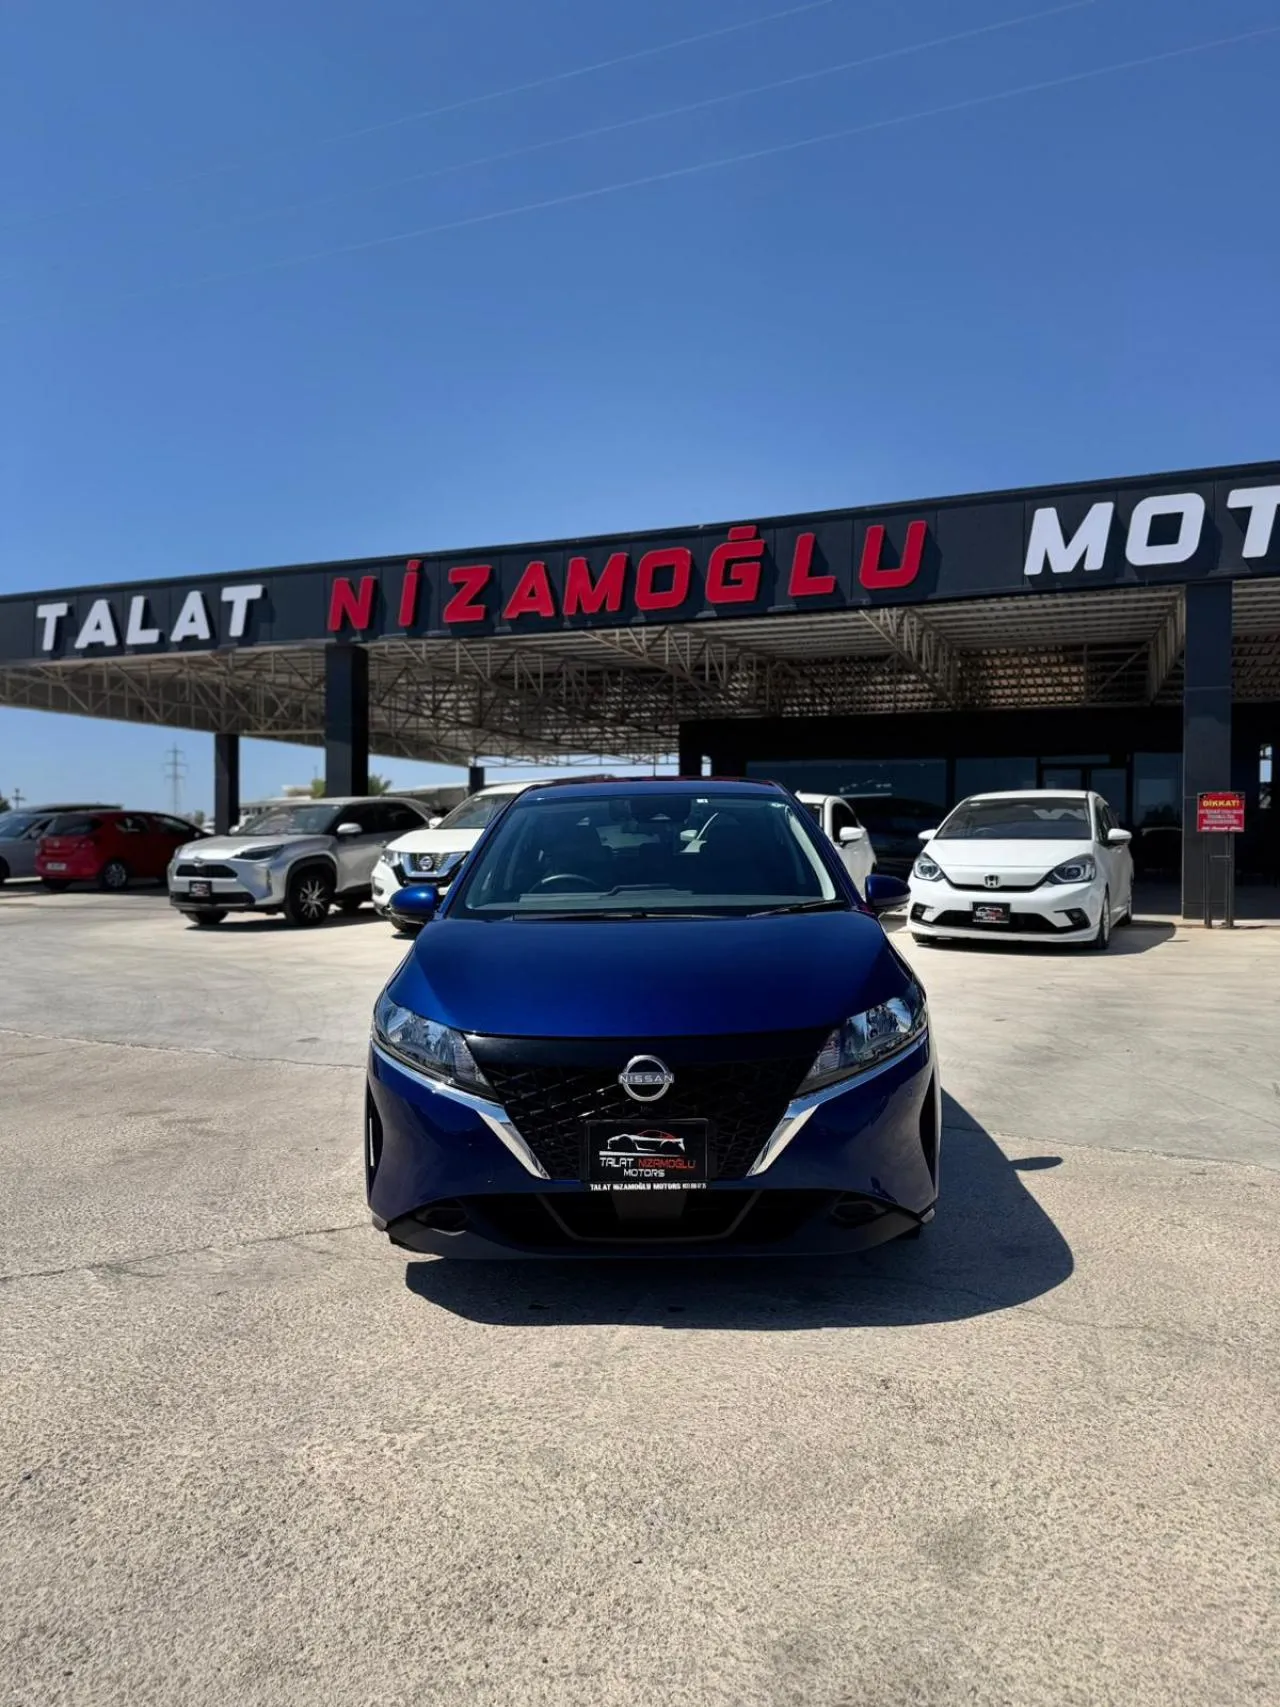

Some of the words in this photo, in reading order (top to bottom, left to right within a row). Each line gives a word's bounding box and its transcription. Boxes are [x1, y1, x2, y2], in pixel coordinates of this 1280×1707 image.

[37, 584, 263, 651] TALAT
[327, 521, 927, 631] NİZAMOĞLU
[1024, 486, 1280, 575] MOT
[619, 1074, 673, 1083] NISSAN
[600, 1157, 634, 1168] TALAT
[623, 1169, 666, 1177] MOTORS
